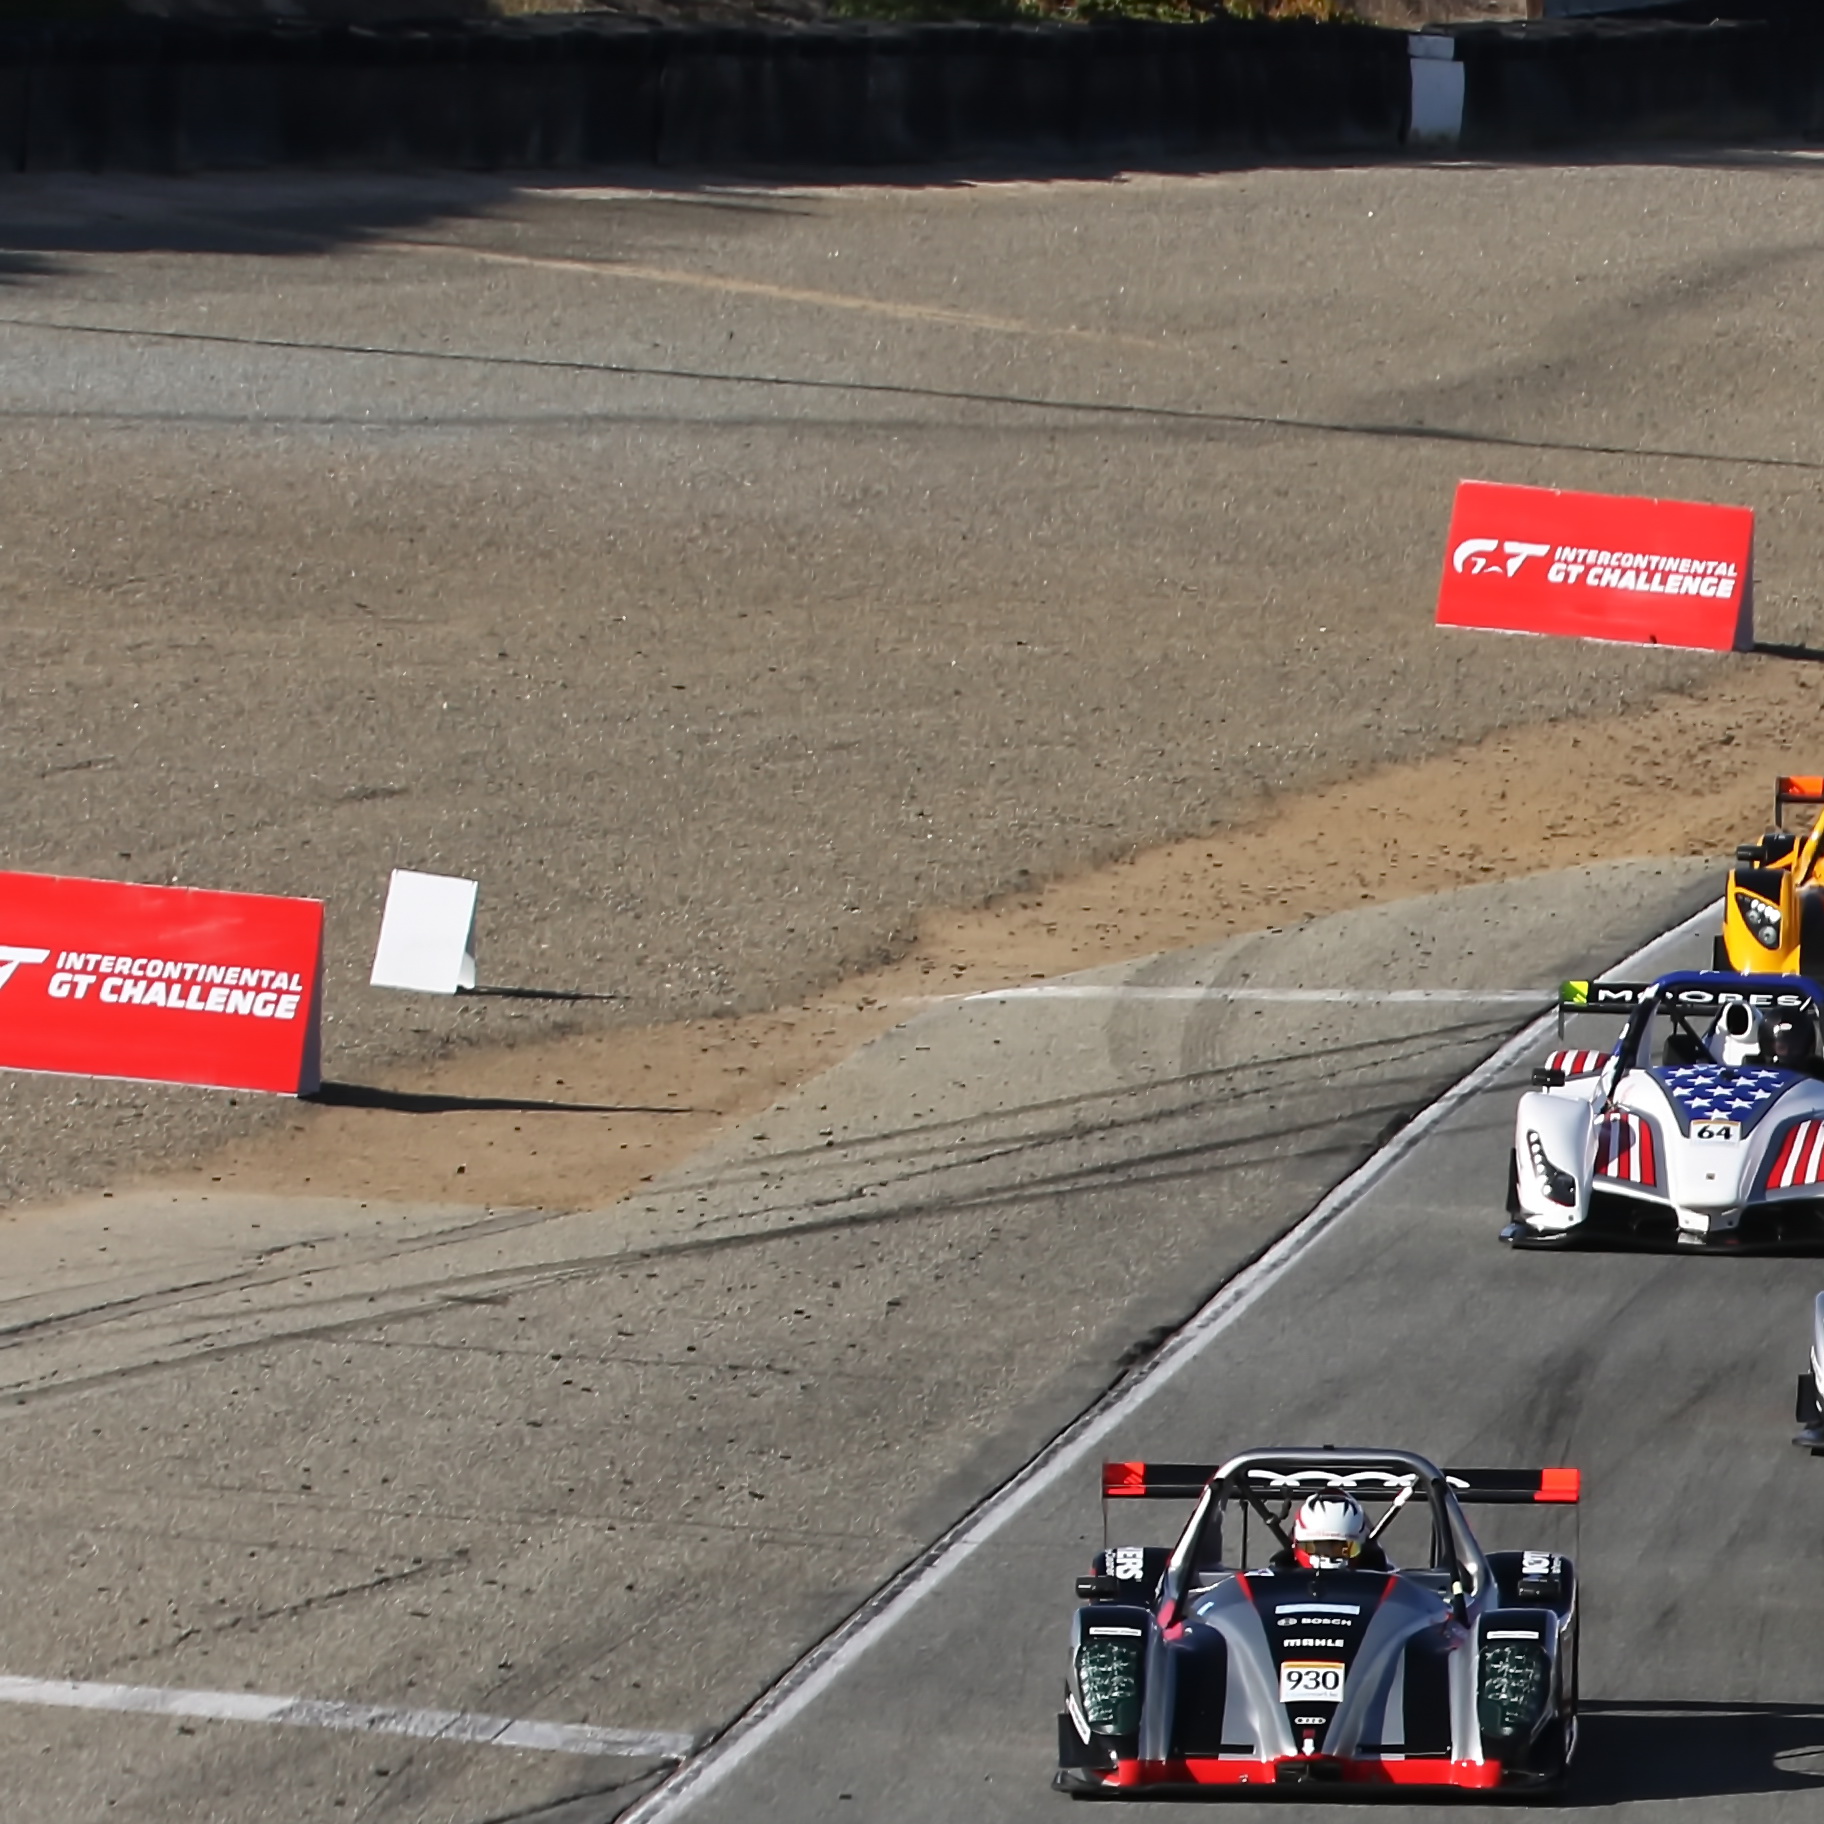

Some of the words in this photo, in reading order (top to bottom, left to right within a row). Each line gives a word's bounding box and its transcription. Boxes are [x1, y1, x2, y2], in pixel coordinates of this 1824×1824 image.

[1554, 546, 1738, 577] INTERCONTINENTAL
[1547, 563, 1584, 584] GT
[1586, 566, 1736, 598] CHALLENGE
[57, 951, 302, 991] INTERCONTINENTAL
[48, 973, 97, 999] GT
[100, 977, 300, 1019] CHALLENGE
[1697, 1124, 1733, 1141] 64
[1301, 1617, 1352, 1627] BOSCH
[1283, 1638, 1345, 1648] MAHLE
[1286, 1670, 1340, 1690] 930
